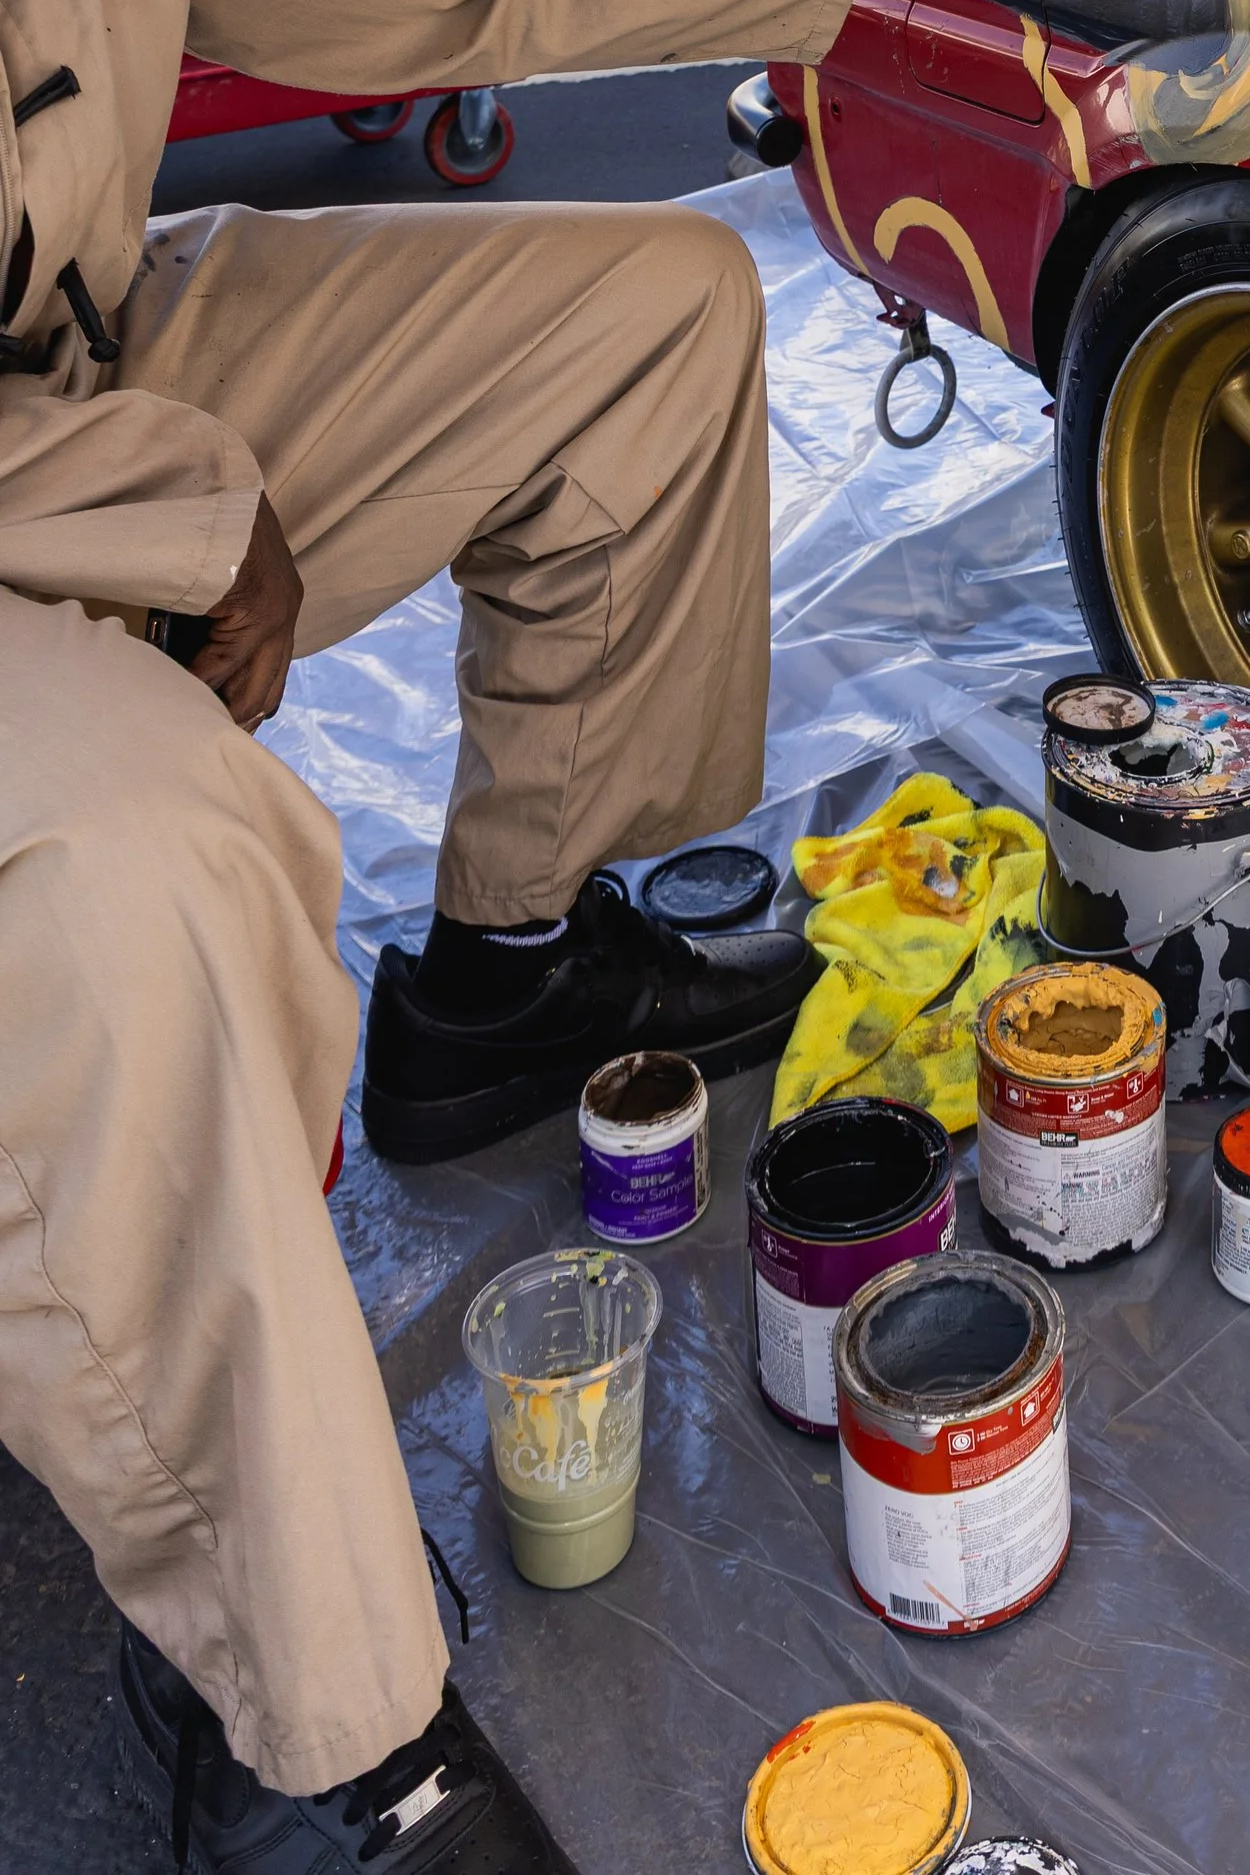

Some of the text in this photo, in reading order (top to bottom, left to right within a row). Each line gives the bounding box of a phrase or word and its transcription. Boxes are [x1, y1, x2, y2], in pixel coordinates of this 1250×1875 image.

[1041, 1132, 1066, 1143] BEHR
[1073, 1169, 1100, 1179] WARNING
[611, 1174, 694, 1204] Color Sample
